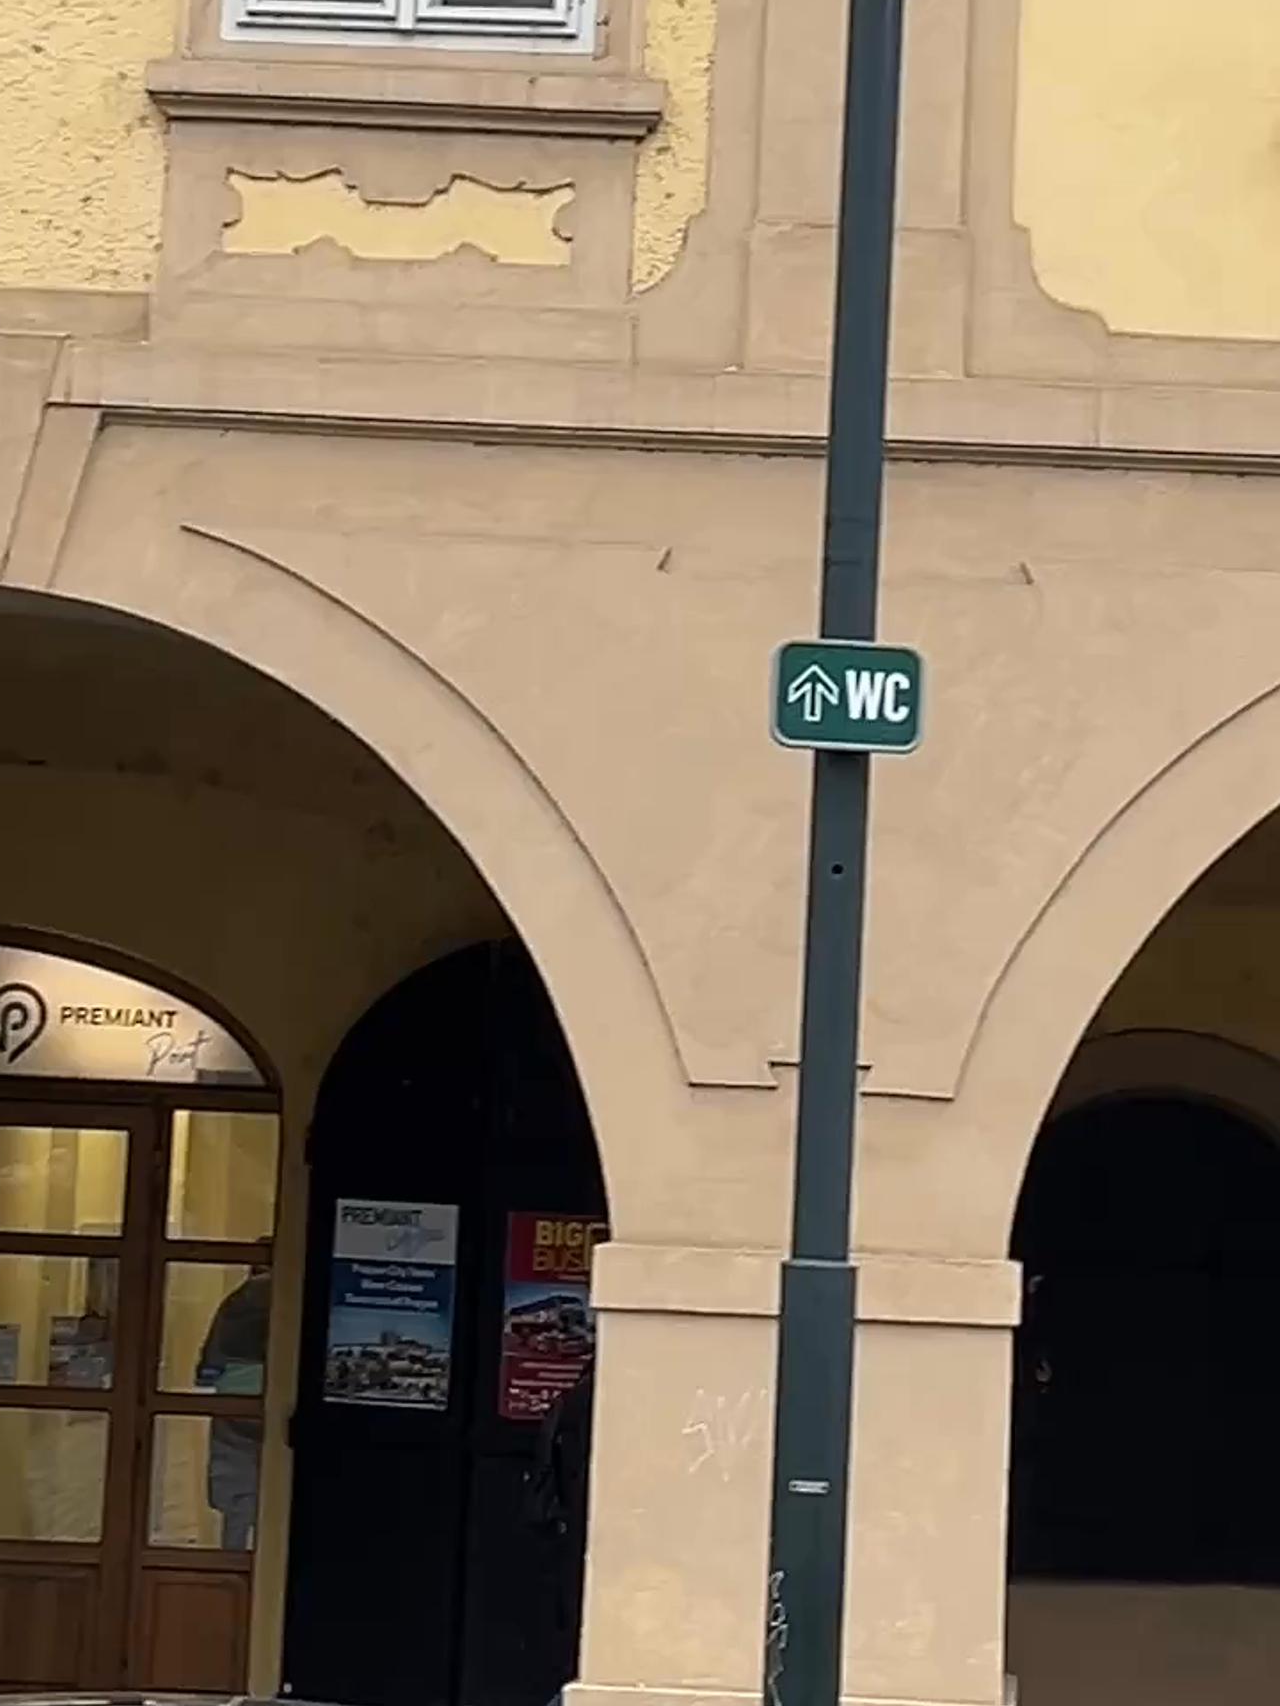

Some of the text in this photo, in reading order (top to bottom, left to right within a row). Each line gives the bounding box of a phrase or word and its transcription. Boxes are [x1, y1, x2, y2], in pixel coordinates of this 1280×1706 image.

[844, 668, 911, 723] WC
[59, 1005, 179, 1029] PREMIANT
[536, 1220, 584, 1246] BIG
